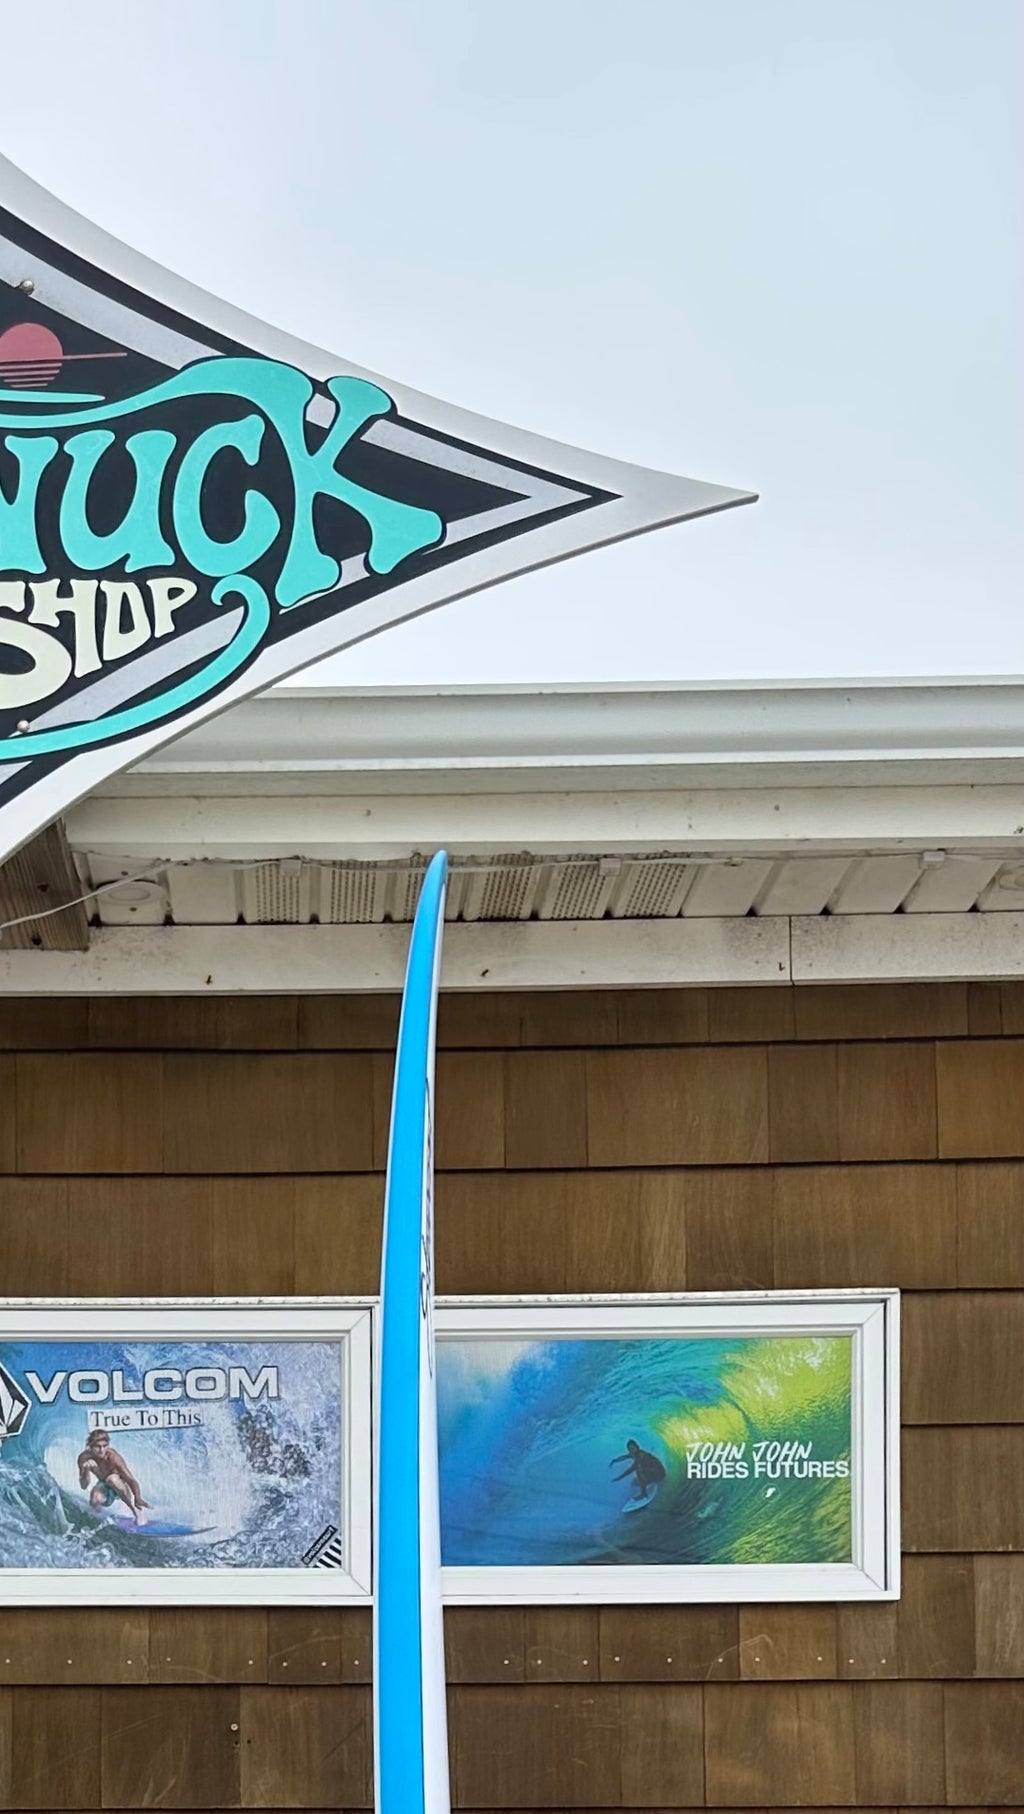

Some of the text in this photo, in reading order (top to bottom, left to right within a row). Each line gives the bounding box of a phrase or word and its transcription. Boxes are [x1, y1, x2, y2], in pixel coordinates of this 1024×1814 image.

[24, 1366, 280, 1404] VOLCOM
[90, 1407, 202, 1428] True To This
[686, 1441, 813, 1465] JOHN JOHN
[687, 1461, 850, 1479] RIDES FUTURES
